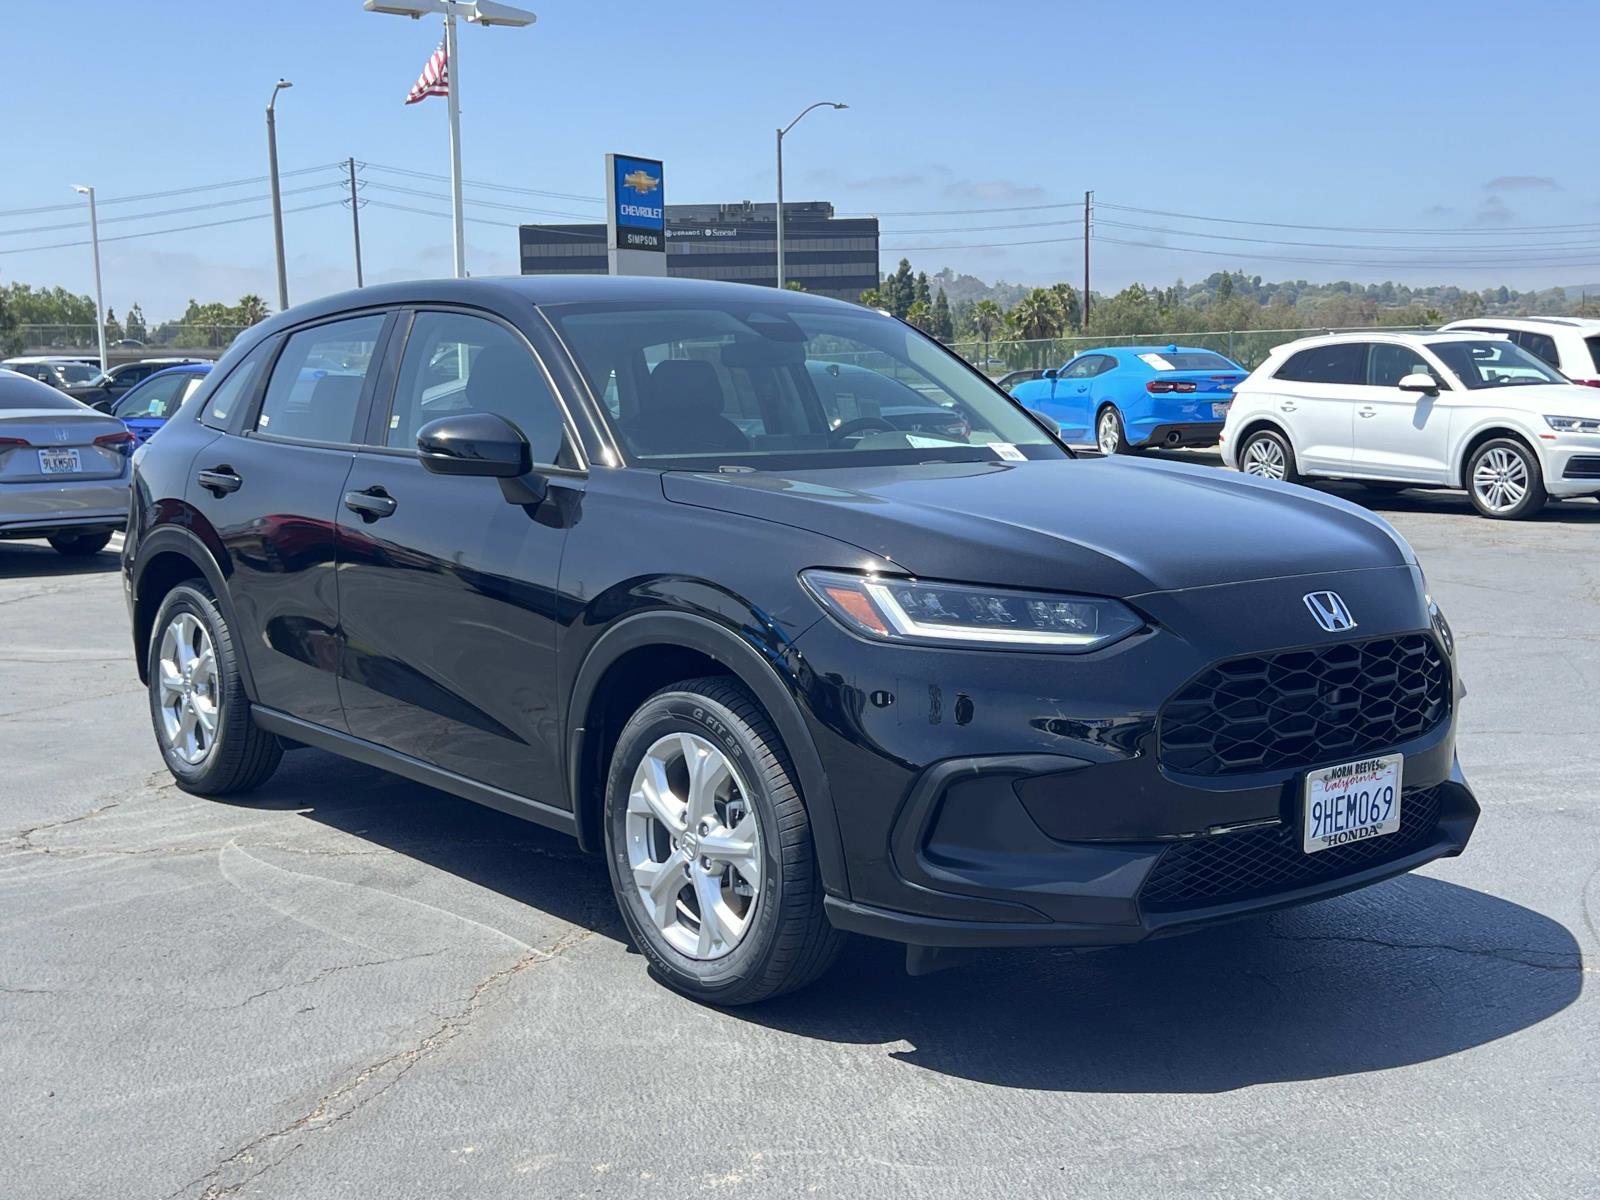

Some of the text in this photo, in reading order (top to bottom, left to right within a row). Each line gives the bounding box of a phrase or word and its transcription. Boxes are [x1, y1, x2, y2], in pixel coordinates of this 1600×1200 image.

[620, 204, 662, 219] CHEVROLET
[627, 233, 658, 246] SIMPSON
[1331, 760, 1381, 781] NORM REEVES
[1325, 772, 1383, 793] California
[1311, 786, 1394, 838] 9HEM069
[1328, 825, 1379, 846] HONDA
